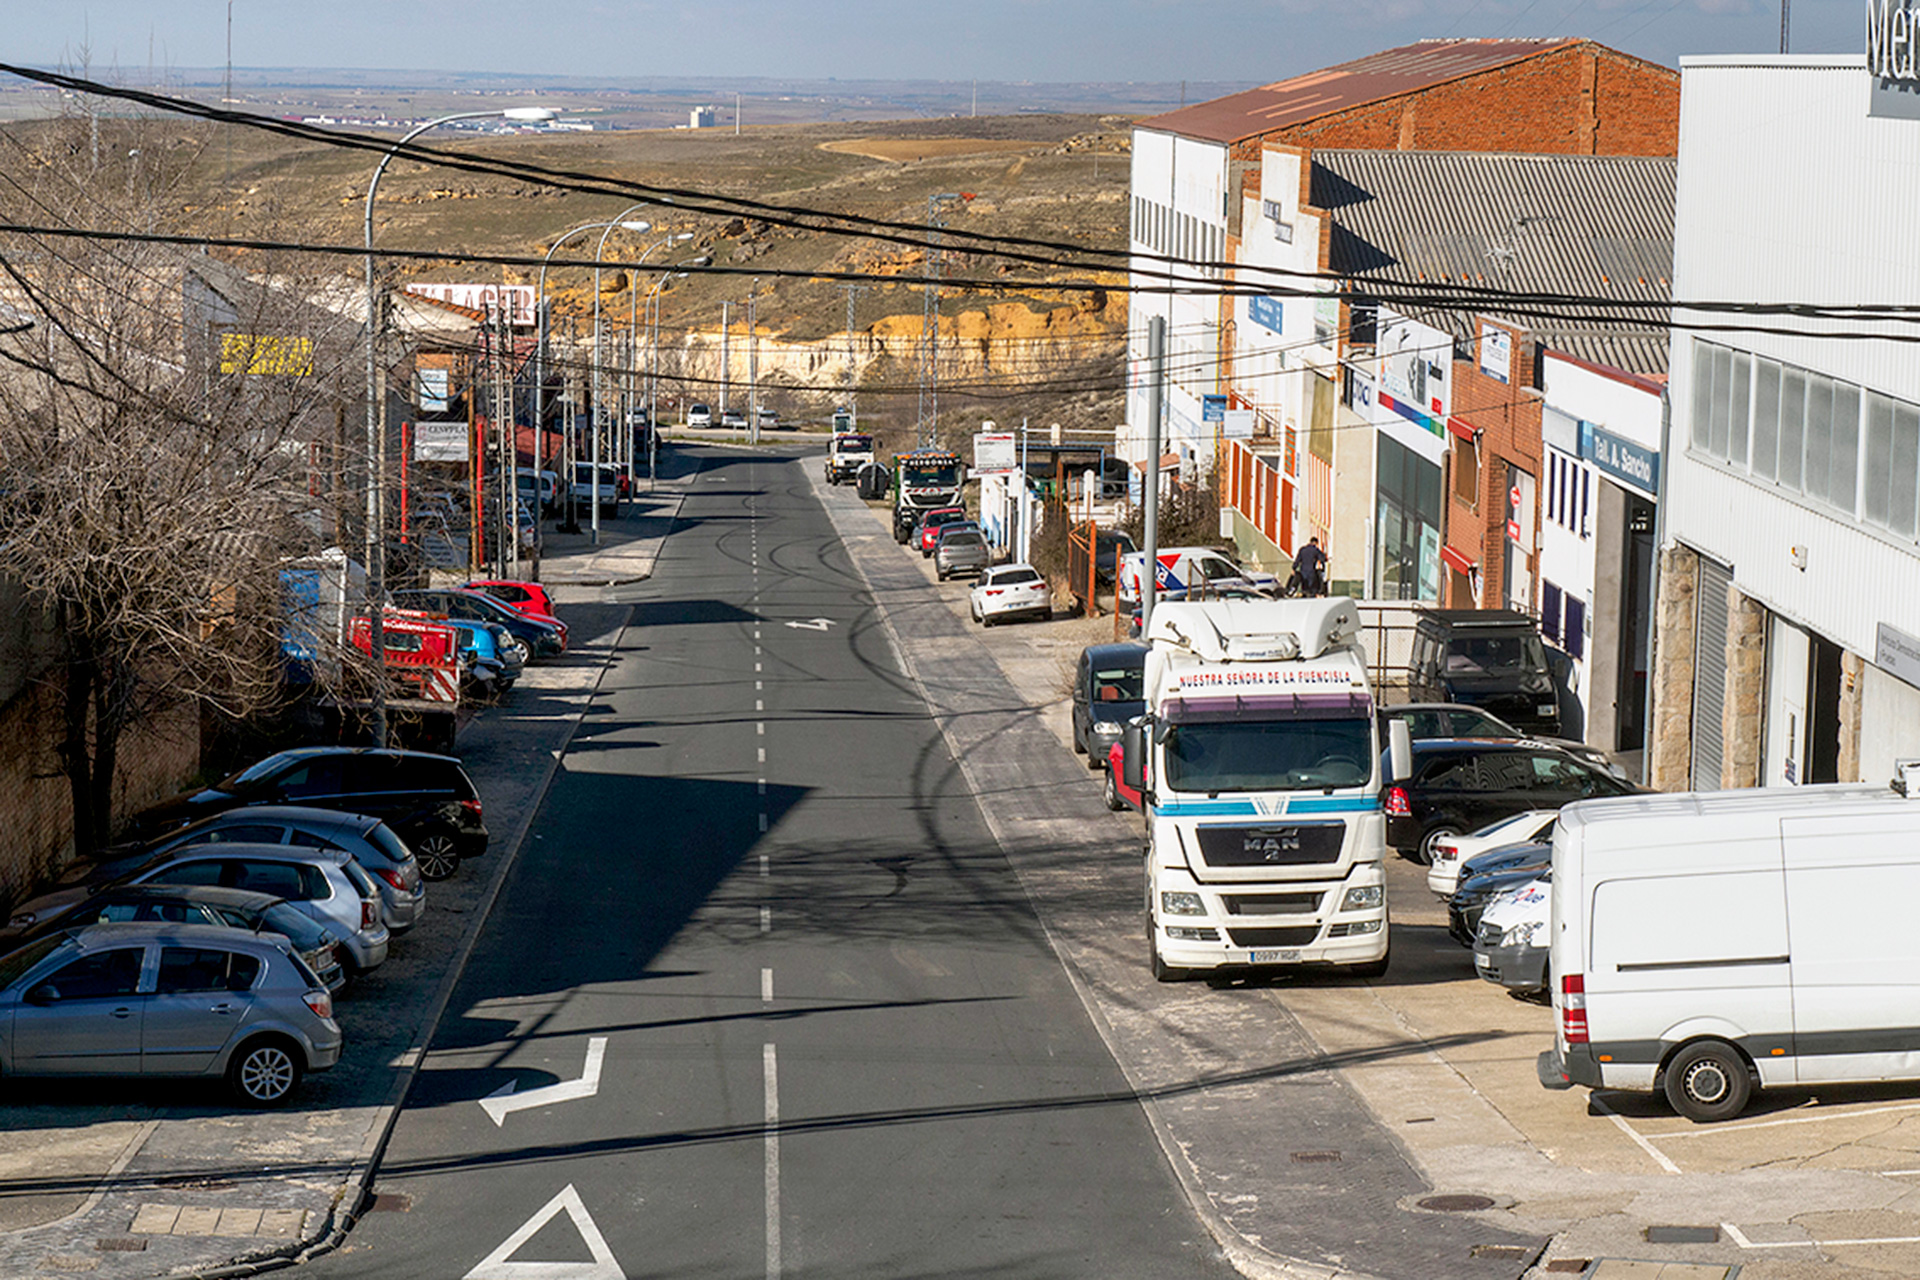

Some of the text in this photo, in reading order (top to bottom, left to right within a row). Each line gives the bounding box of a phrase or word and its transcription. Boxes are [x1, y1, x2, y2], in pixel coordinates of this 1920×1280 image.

[1621, 447, 1651, 483] Sancho
[1179, 669, 1352, 688] NUESTRA SEÑORA DE LA FUENCISLA
[1243, 838, 1300, 851] MAN
